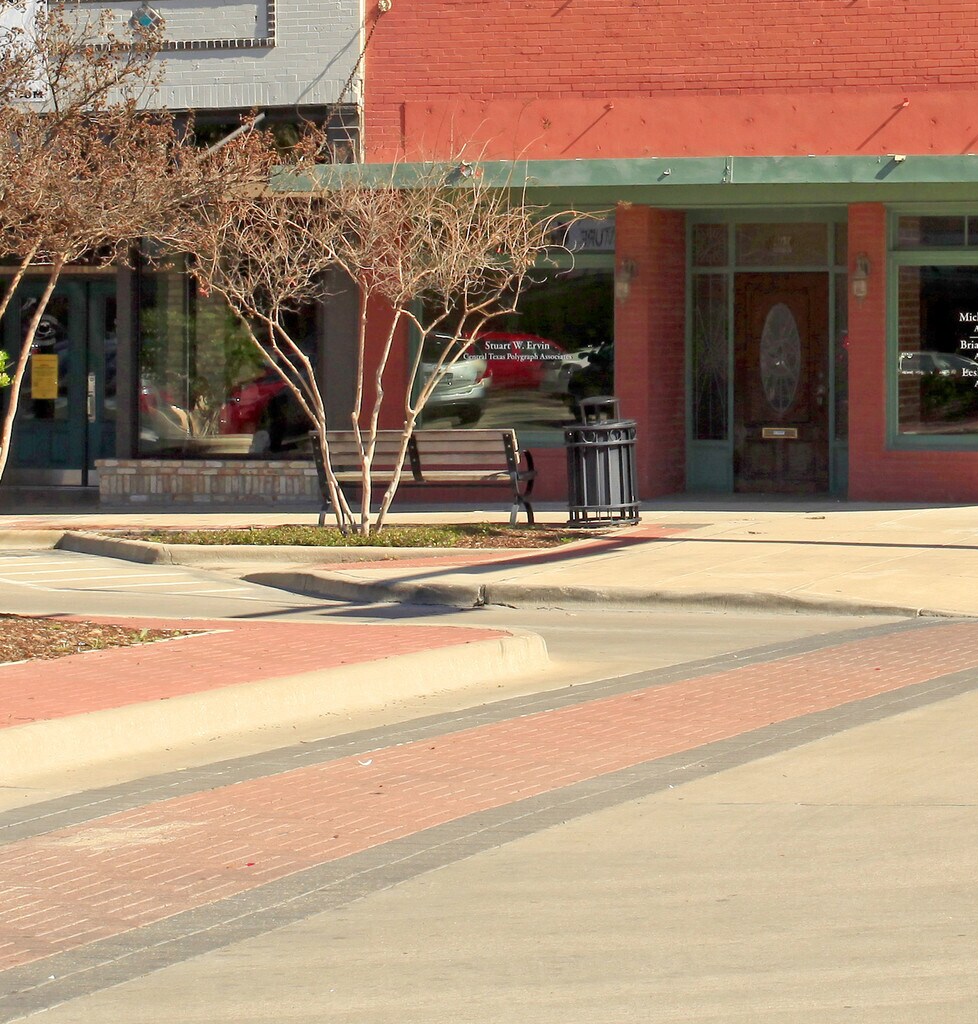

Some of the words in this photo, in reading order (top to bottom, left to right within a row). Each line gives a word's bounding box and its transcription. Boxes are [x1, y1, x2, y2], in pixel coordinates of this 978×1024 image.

[485, 341, 511, 350] Stuart
[512, 341, 525, 350] W.
[527, 341, 550, 350] Ervin
[507, 353, 538, 361] Polygraph
